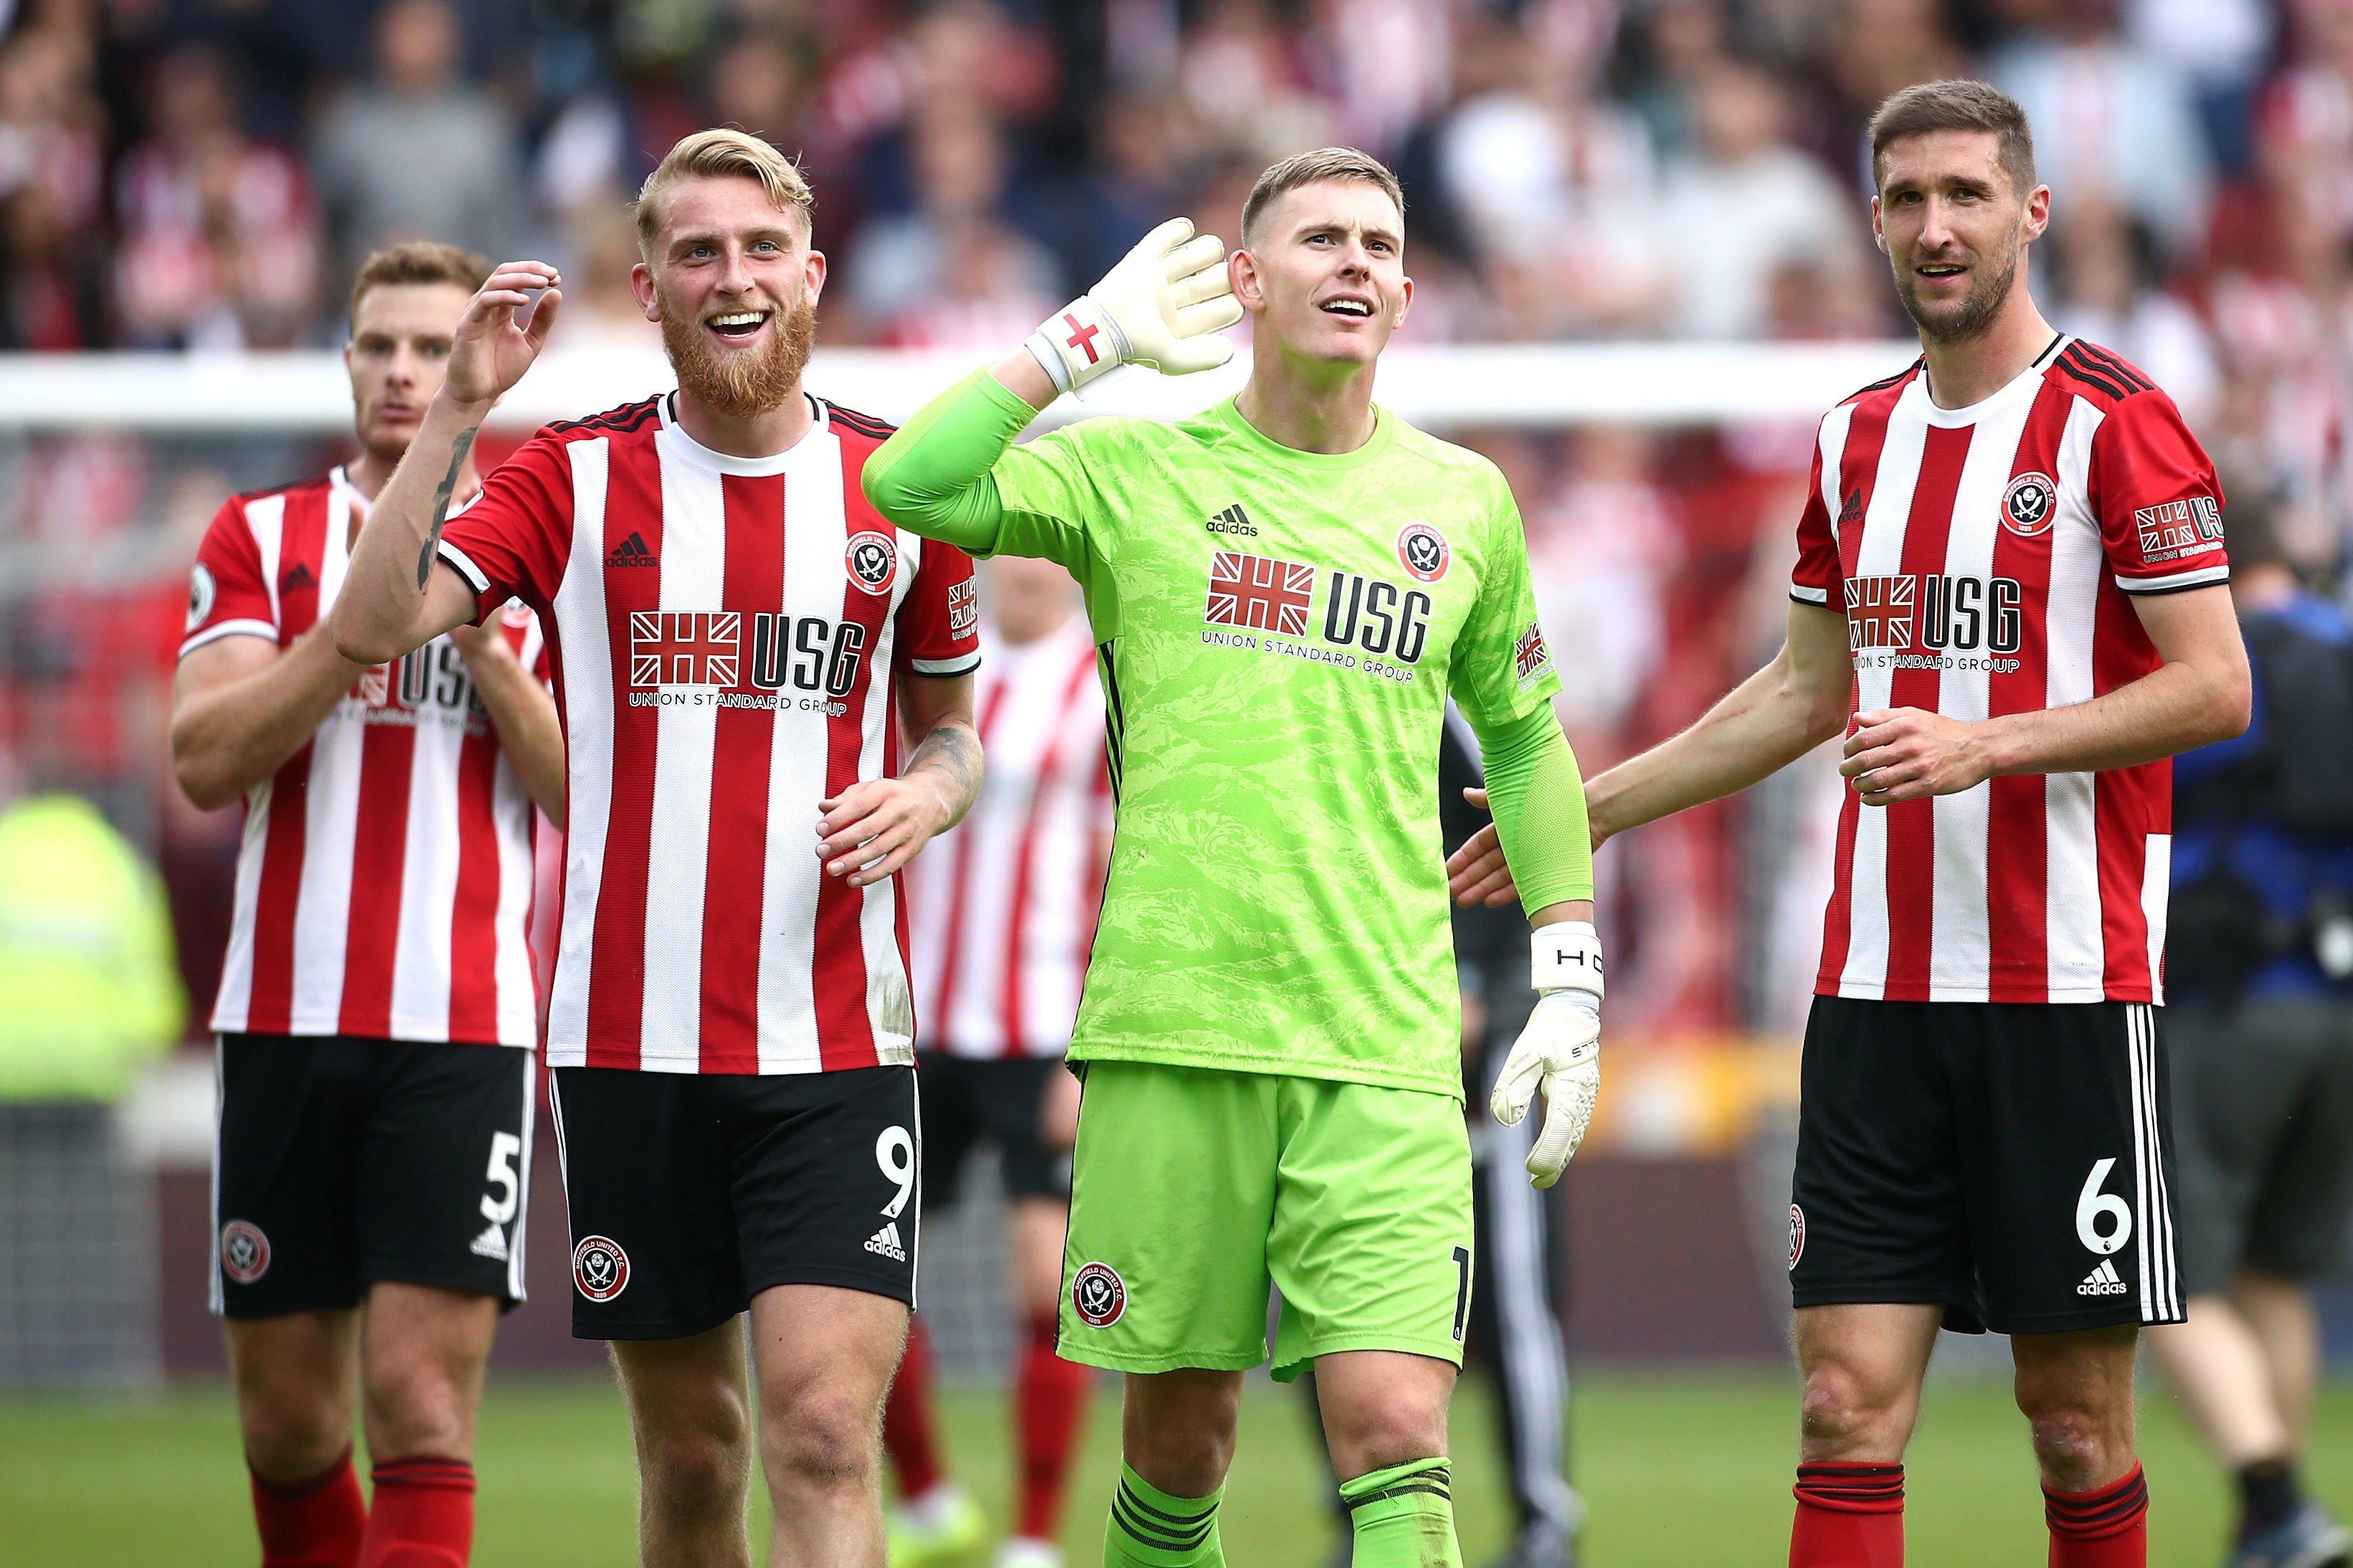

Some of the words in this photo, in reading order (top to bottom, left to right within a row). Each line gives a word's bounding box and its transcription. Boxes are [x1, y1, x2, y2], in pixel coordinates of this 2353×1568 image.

[2003, 476, 2032, 502] SHEFFIELD
[2032, 476, 2052, 493] UNITED
[1206, 521, 1258, 536] adidas
[605, 554, 657, 567] adidas
[846, 536, 873, 559] SHEFFIELD
[874, 536, 894, 556] UNITED
[2143, 550, 2178, 564] UNION
[1324, 571, 1431, 664] USG
[1923, 576, 2019, 652] USG
[753, 614, 865, 696] USG
[1201, 630, 1256, 650] UNION
[1264, 640, 1356, 667] STANDARD
[1363, 660, 1414, 683] GROUP
[1878, 655, 1954, 670] STANDARD
[1958, 657, 2020, 673] GROUP
[630, 693, 686, 706] UNION
[693, 693, 791, 710] STANDARD
[799, 698, 847, 717] GROUP
[480, 1131, 520, 1224] 5
[876, 1125, 914, 1219] 9
[2075, 1157, 2132, 1255] 6
[576, 1241, 595, 1269] SHEFFIELD
[596, 1240, 618, 1256] UNITED
[863, 1240, 906, 1263] adidas
[1075, 1267, 1099, 1291] SHEFFIELD
[1099, 1268, 1119, 1288] UNITED
[2076, 1281, 2127, 1296] adidas
[1452, 1245, 1469, 1341] 1
